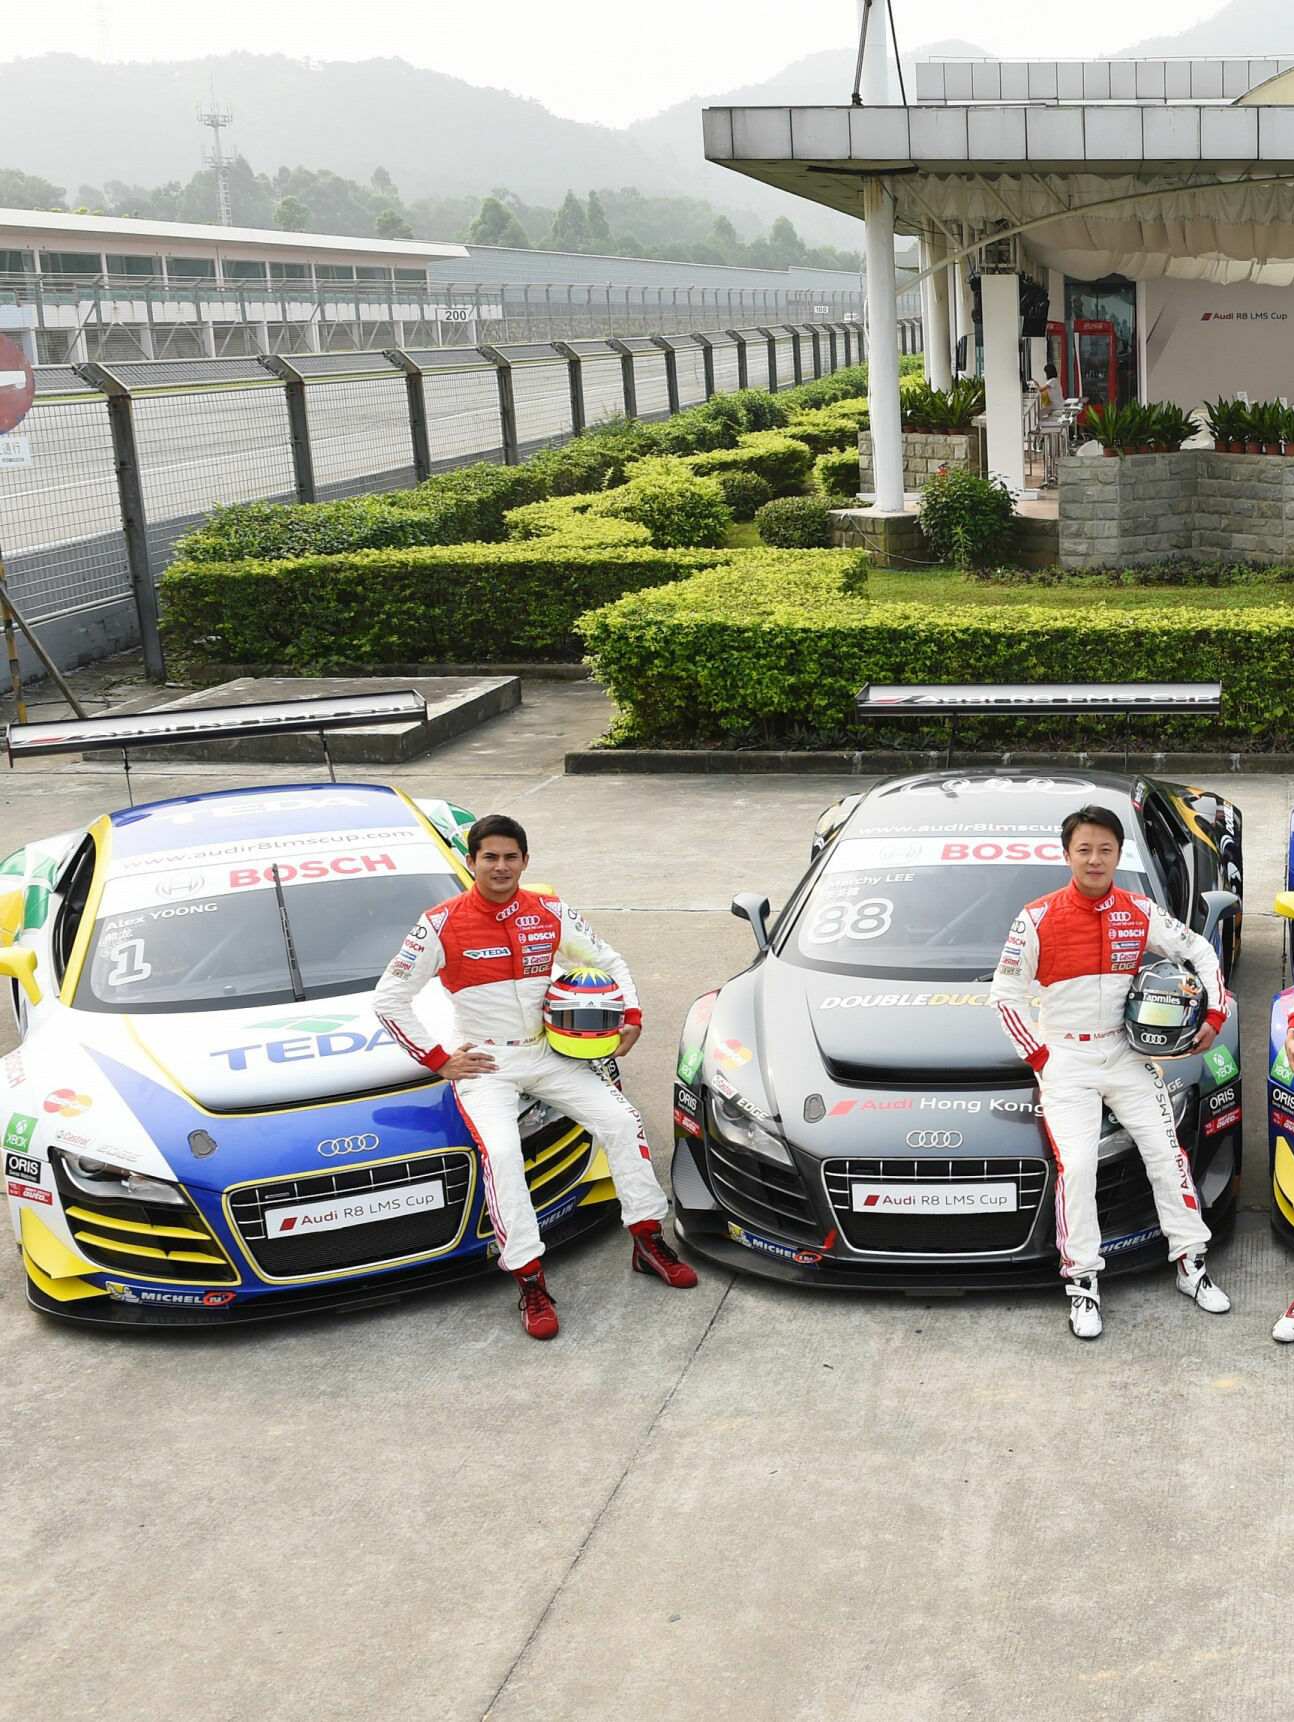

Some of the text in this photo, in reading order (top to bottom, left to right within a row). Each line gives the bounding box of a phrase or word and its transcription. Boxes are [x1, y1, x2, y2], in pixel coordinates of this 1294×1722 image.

[445, 310, 467, 321] 200
[1213, 312, 1233, 320] Audi
[1270, 313, 1288, 321] Cup
[859, 822, 1065, 834] www.audir8lmscup
[122, 828, 415, 870] www.audir8lmscup.com
[941, 843, 1063, 861] BOSC
[229, 853, 397, 888] BOSCH
[885, 873, 916, 883] LEE
[105, 902, 218, 932] Alex YOONG
[806, 897, 894, 945] 88
[528, 931, 555, 942] BOSCH
[1118, 929, 1145, 938] BOSCH
[405, 939, 425, 952] OSCH
[481, 949, 508, 957] TEDA
[108, 938, 151, 987] 1
[530, 954, 550, 964] Castrol
[1111, 962, 1137, 971] EDGE
[523, 963, 550, 975] EDGE
[1143, 992, 1181, 1005] Tapmiles
[209, 1027, 399, 1071] TEDA
[1215, 1063, 1235, 1079] XBOX
[1274, 1062, 1293, 1082] XBOX
[678, 1089, 697, 1111] ORIS
[859, 1097, 1044, 1117] Audi Hong Kong
[1209, 1088, 1235, 1110] ORIS
[736, 1097, 769, 1122] EDGE
[1144, 1062, 1190, 1190] Audi R8 LMS Cup
[6, 1132, 28, 1149] XBOX
[8, 1156, 40, 1176] ORIS
[883, 1193, 1008, 1207] Audi R8 LMS Cup
[301, 1193, 434, 1226] Audi R8 LMS Cup
[141, 1291, 222, 1304] MICHELN
